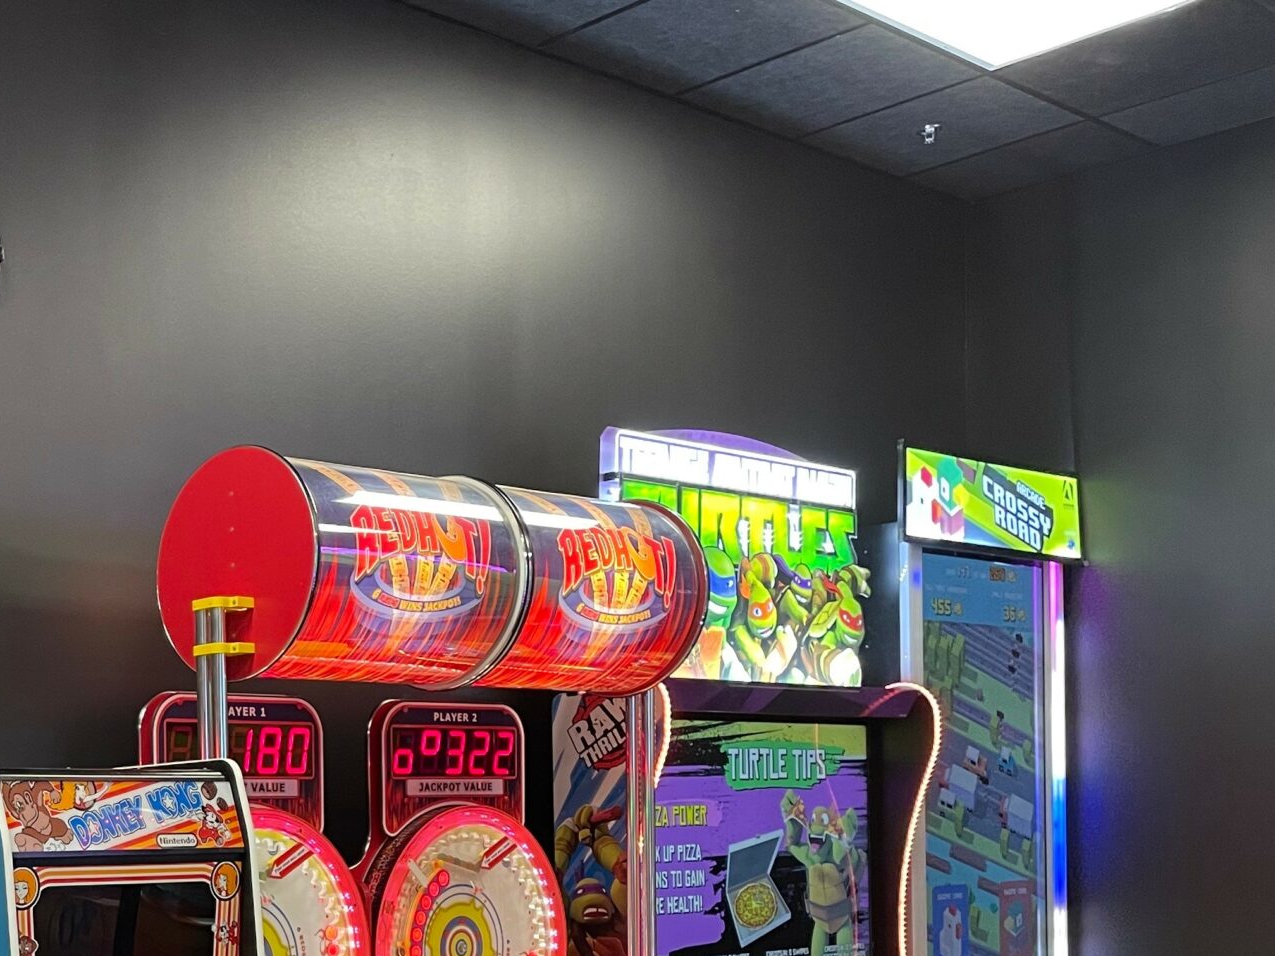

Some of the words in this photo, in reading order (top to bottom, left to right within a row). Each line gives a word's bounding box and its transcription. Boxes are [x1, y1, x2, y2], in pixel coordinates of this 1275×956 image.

[982, 474, 1051, 536] CROSSY
[995, 504, 1041, 551] ROAD
[260, 706, 267, 717] 1
[433, 711, 469, 722] PLAYER
[471, 713, 478, 722] 2
[243, 726, 311, 775] 180
[579, 721, 626, 768] THRIL
[728, 748, 788, 781] TURTLE
[792, 748, 826, 780] TIPS
[251, 782, 286, 793] VALUE
[419, 781, 461, 793] JACKPOT
[463, 782, 493, 792] VALUE
[69, 795, 146, 850] DONKEY
[146, 779, 203, 824] KONG
[673, 804, 707, 826] POWER
[159, 836, 196, 845] Nintendo
[664, 846, 675, 861] UP
[678, 844, 702, 861] PIZZA
[670, 870, 683, 887] TO
[685, 869, 705, 886] GAIN
[667, 894, 703, 913] HEALTH!
